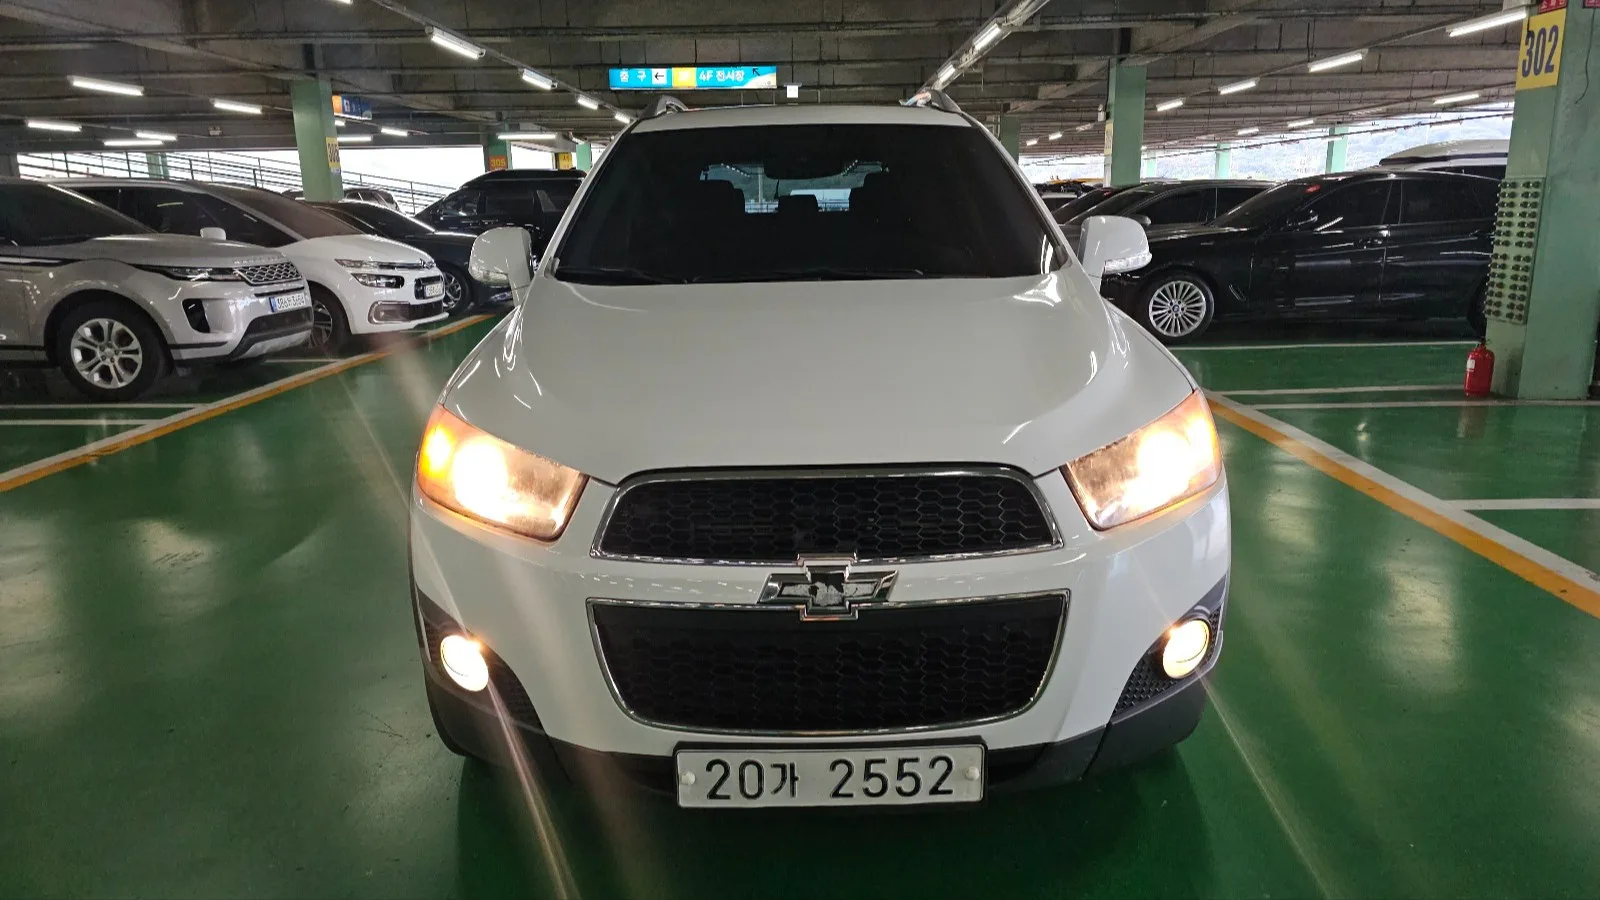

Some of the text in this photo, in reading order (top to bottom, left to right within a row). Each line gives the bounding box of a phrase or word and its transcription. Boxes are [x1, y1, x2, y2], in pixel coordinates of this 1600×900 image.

[1522, 25, 1559, 78] 302
[699, 70, 714, 82] 4F
[705, 755, 954, 800] 20가 2552
